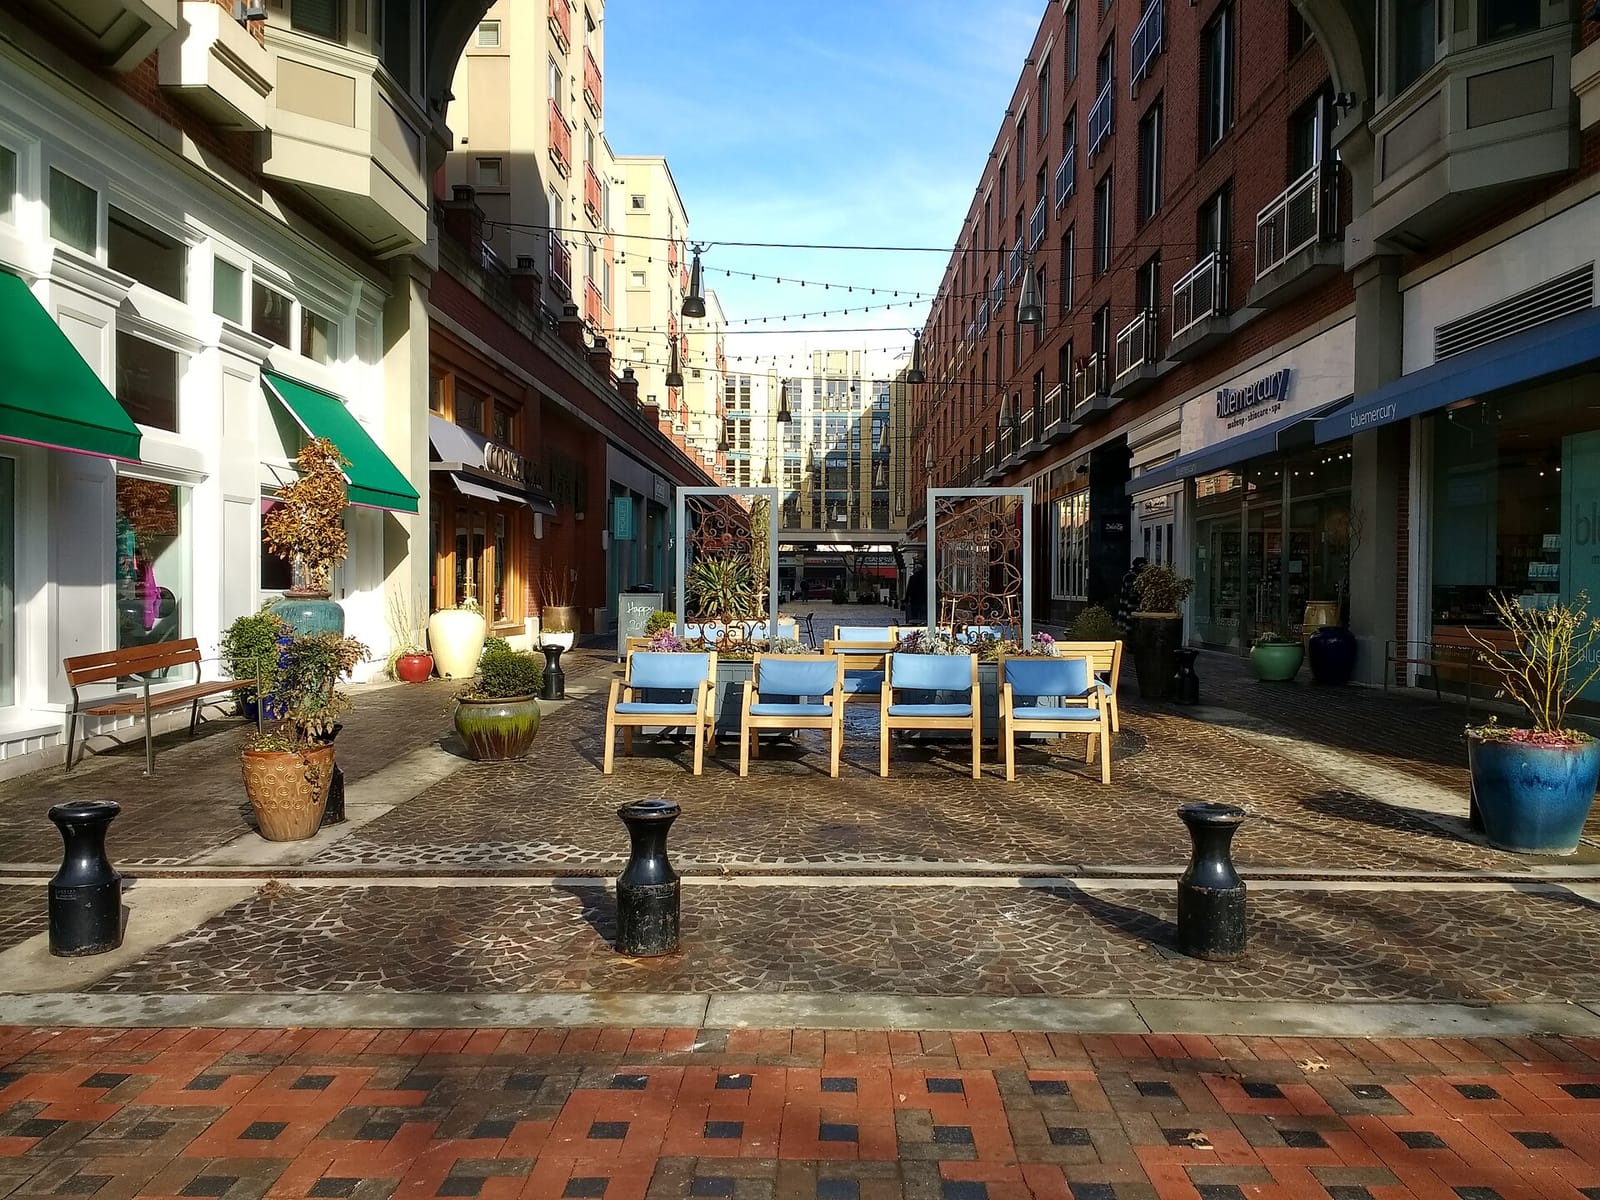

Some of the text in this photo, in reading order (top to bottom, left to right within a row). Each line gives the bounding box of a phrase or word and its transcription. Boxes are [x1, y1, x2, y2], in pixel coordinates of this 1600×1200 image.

[1216, 368, 1291, 419] bluemercury
[1271, 402, 1281, 414] spa
[1350, 402, 1397, 429] bluemercury
[626, 601, 655, 617] Happy
